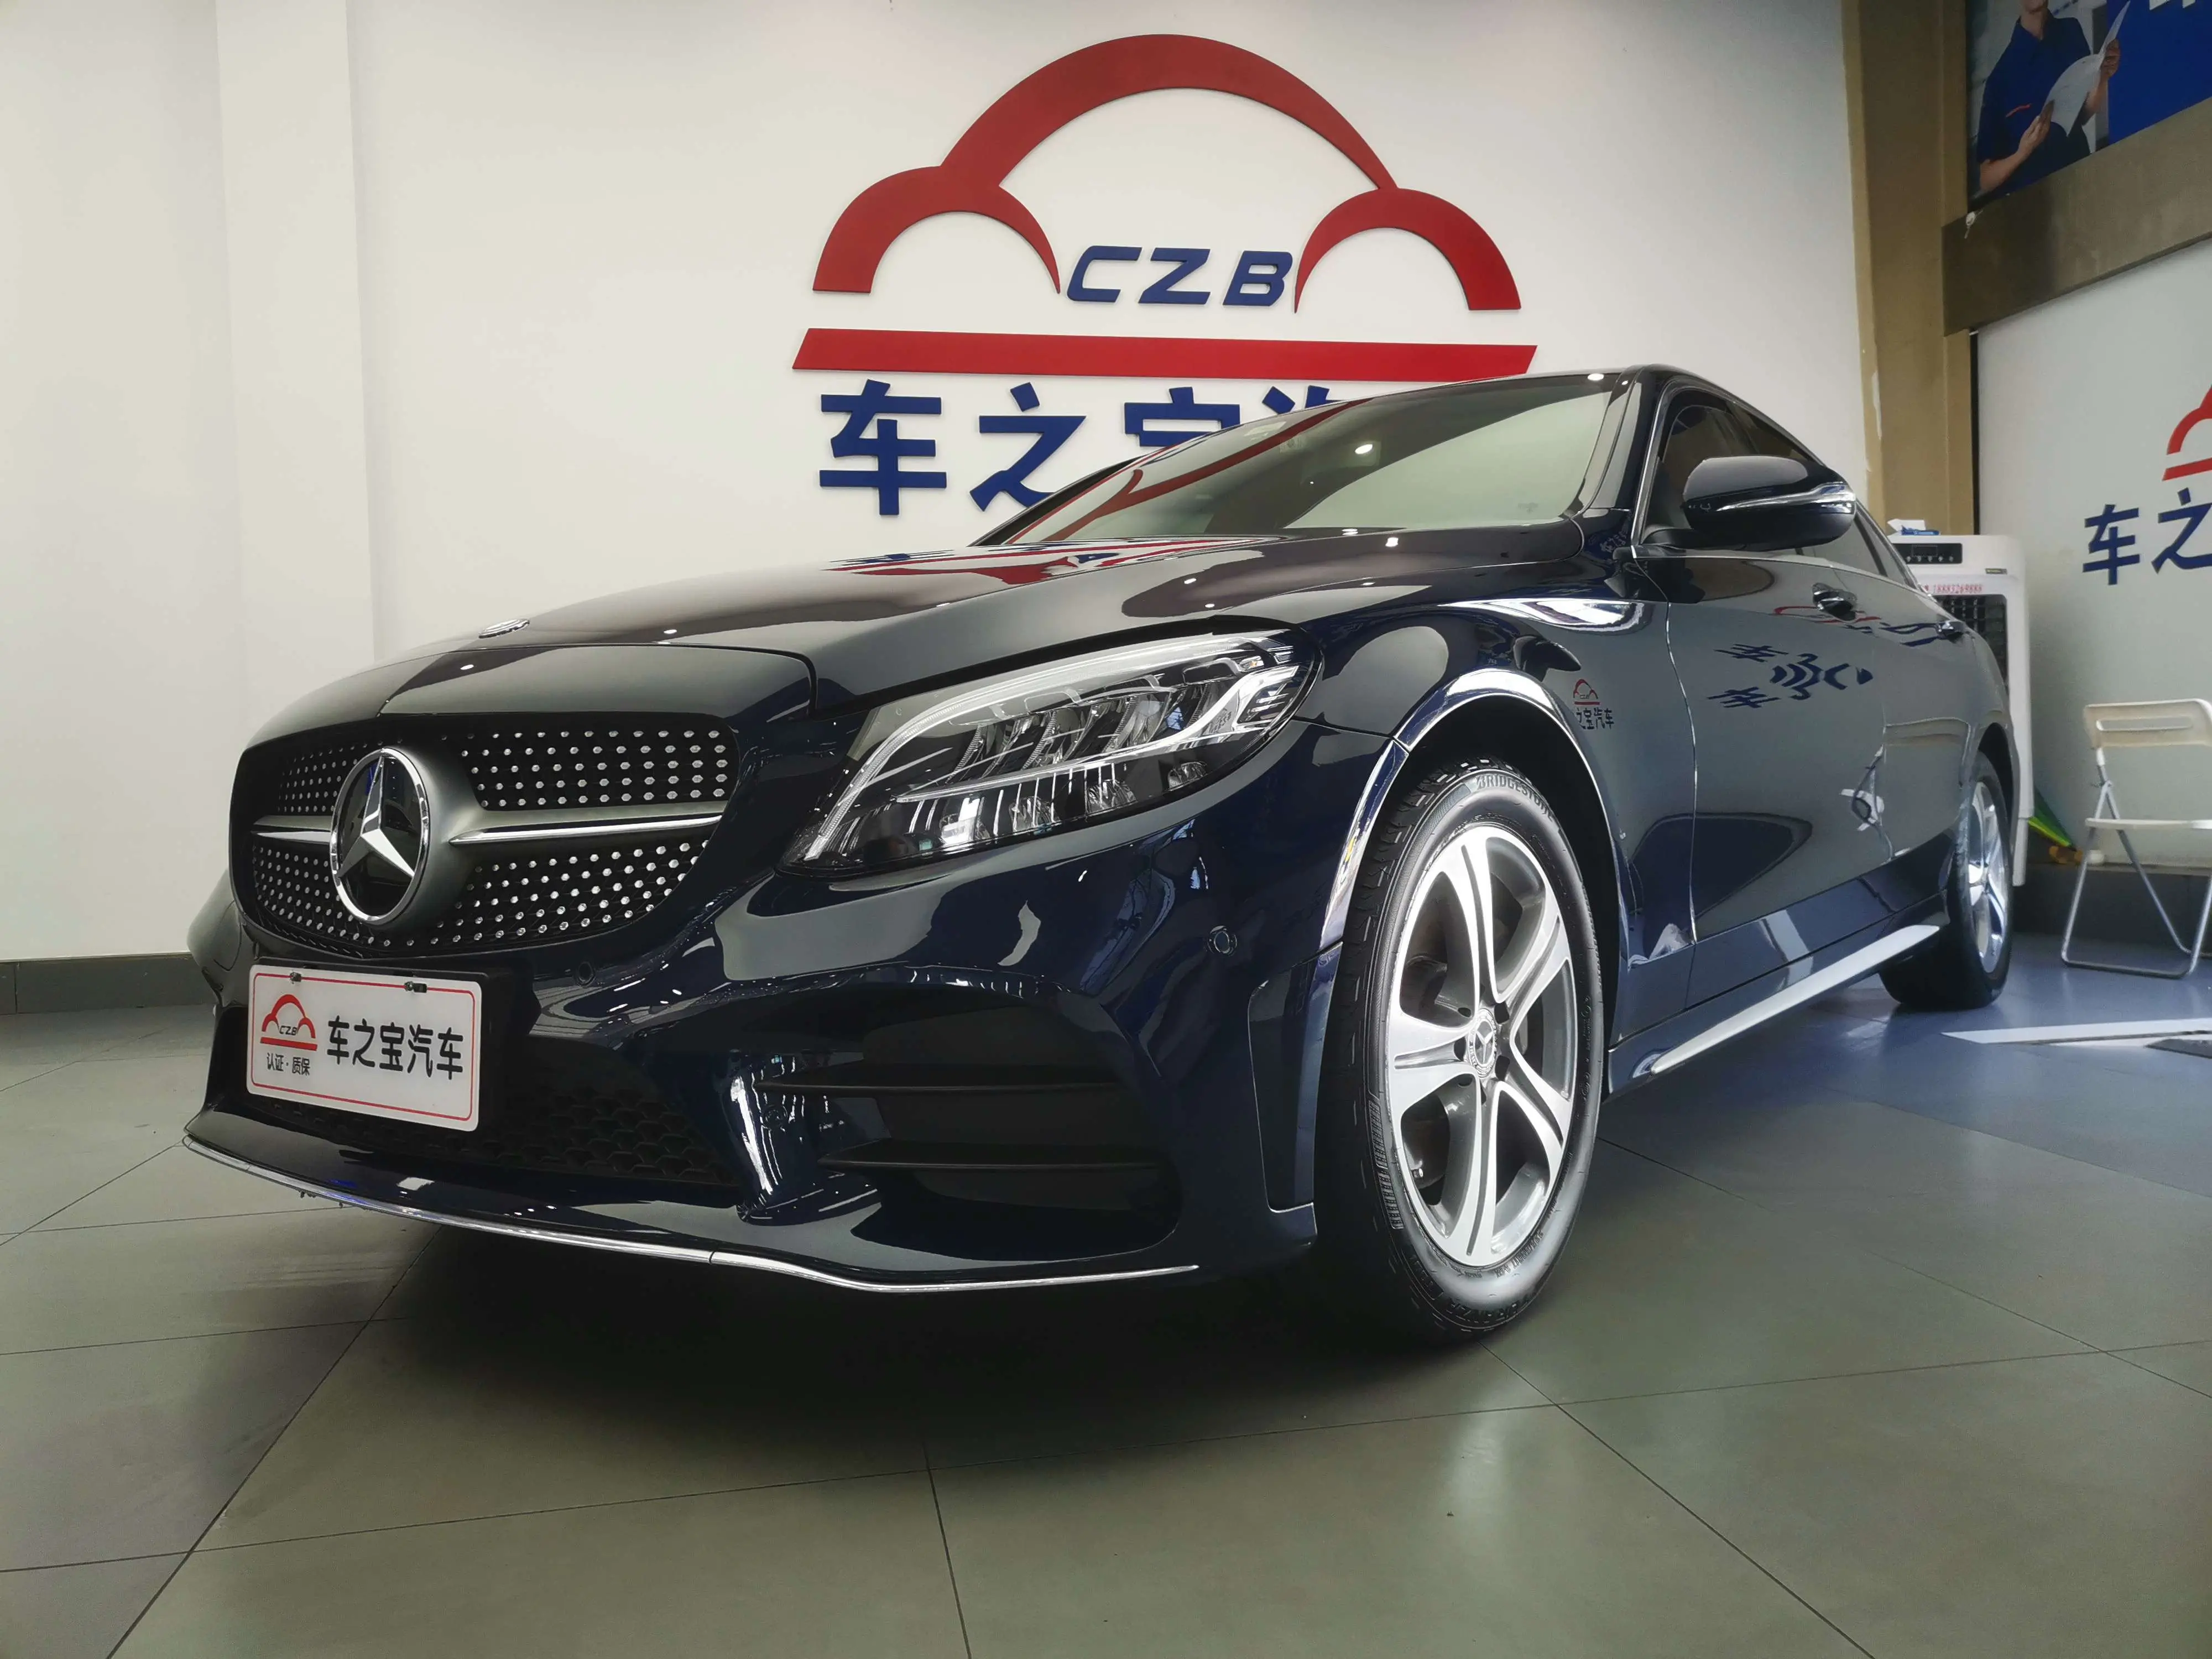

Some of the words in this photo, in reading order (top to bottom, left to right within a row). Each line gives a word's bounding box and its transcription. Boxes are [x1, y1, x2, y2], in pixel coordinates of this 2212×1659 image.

[1067, 245, 1294, 307] CZB
[1477, 773, 1553, 822] BRIDGESTONE
[279, 1025, 298, 1036] CZB
[327, 1015, 463, 1080] 车之宝汽车
